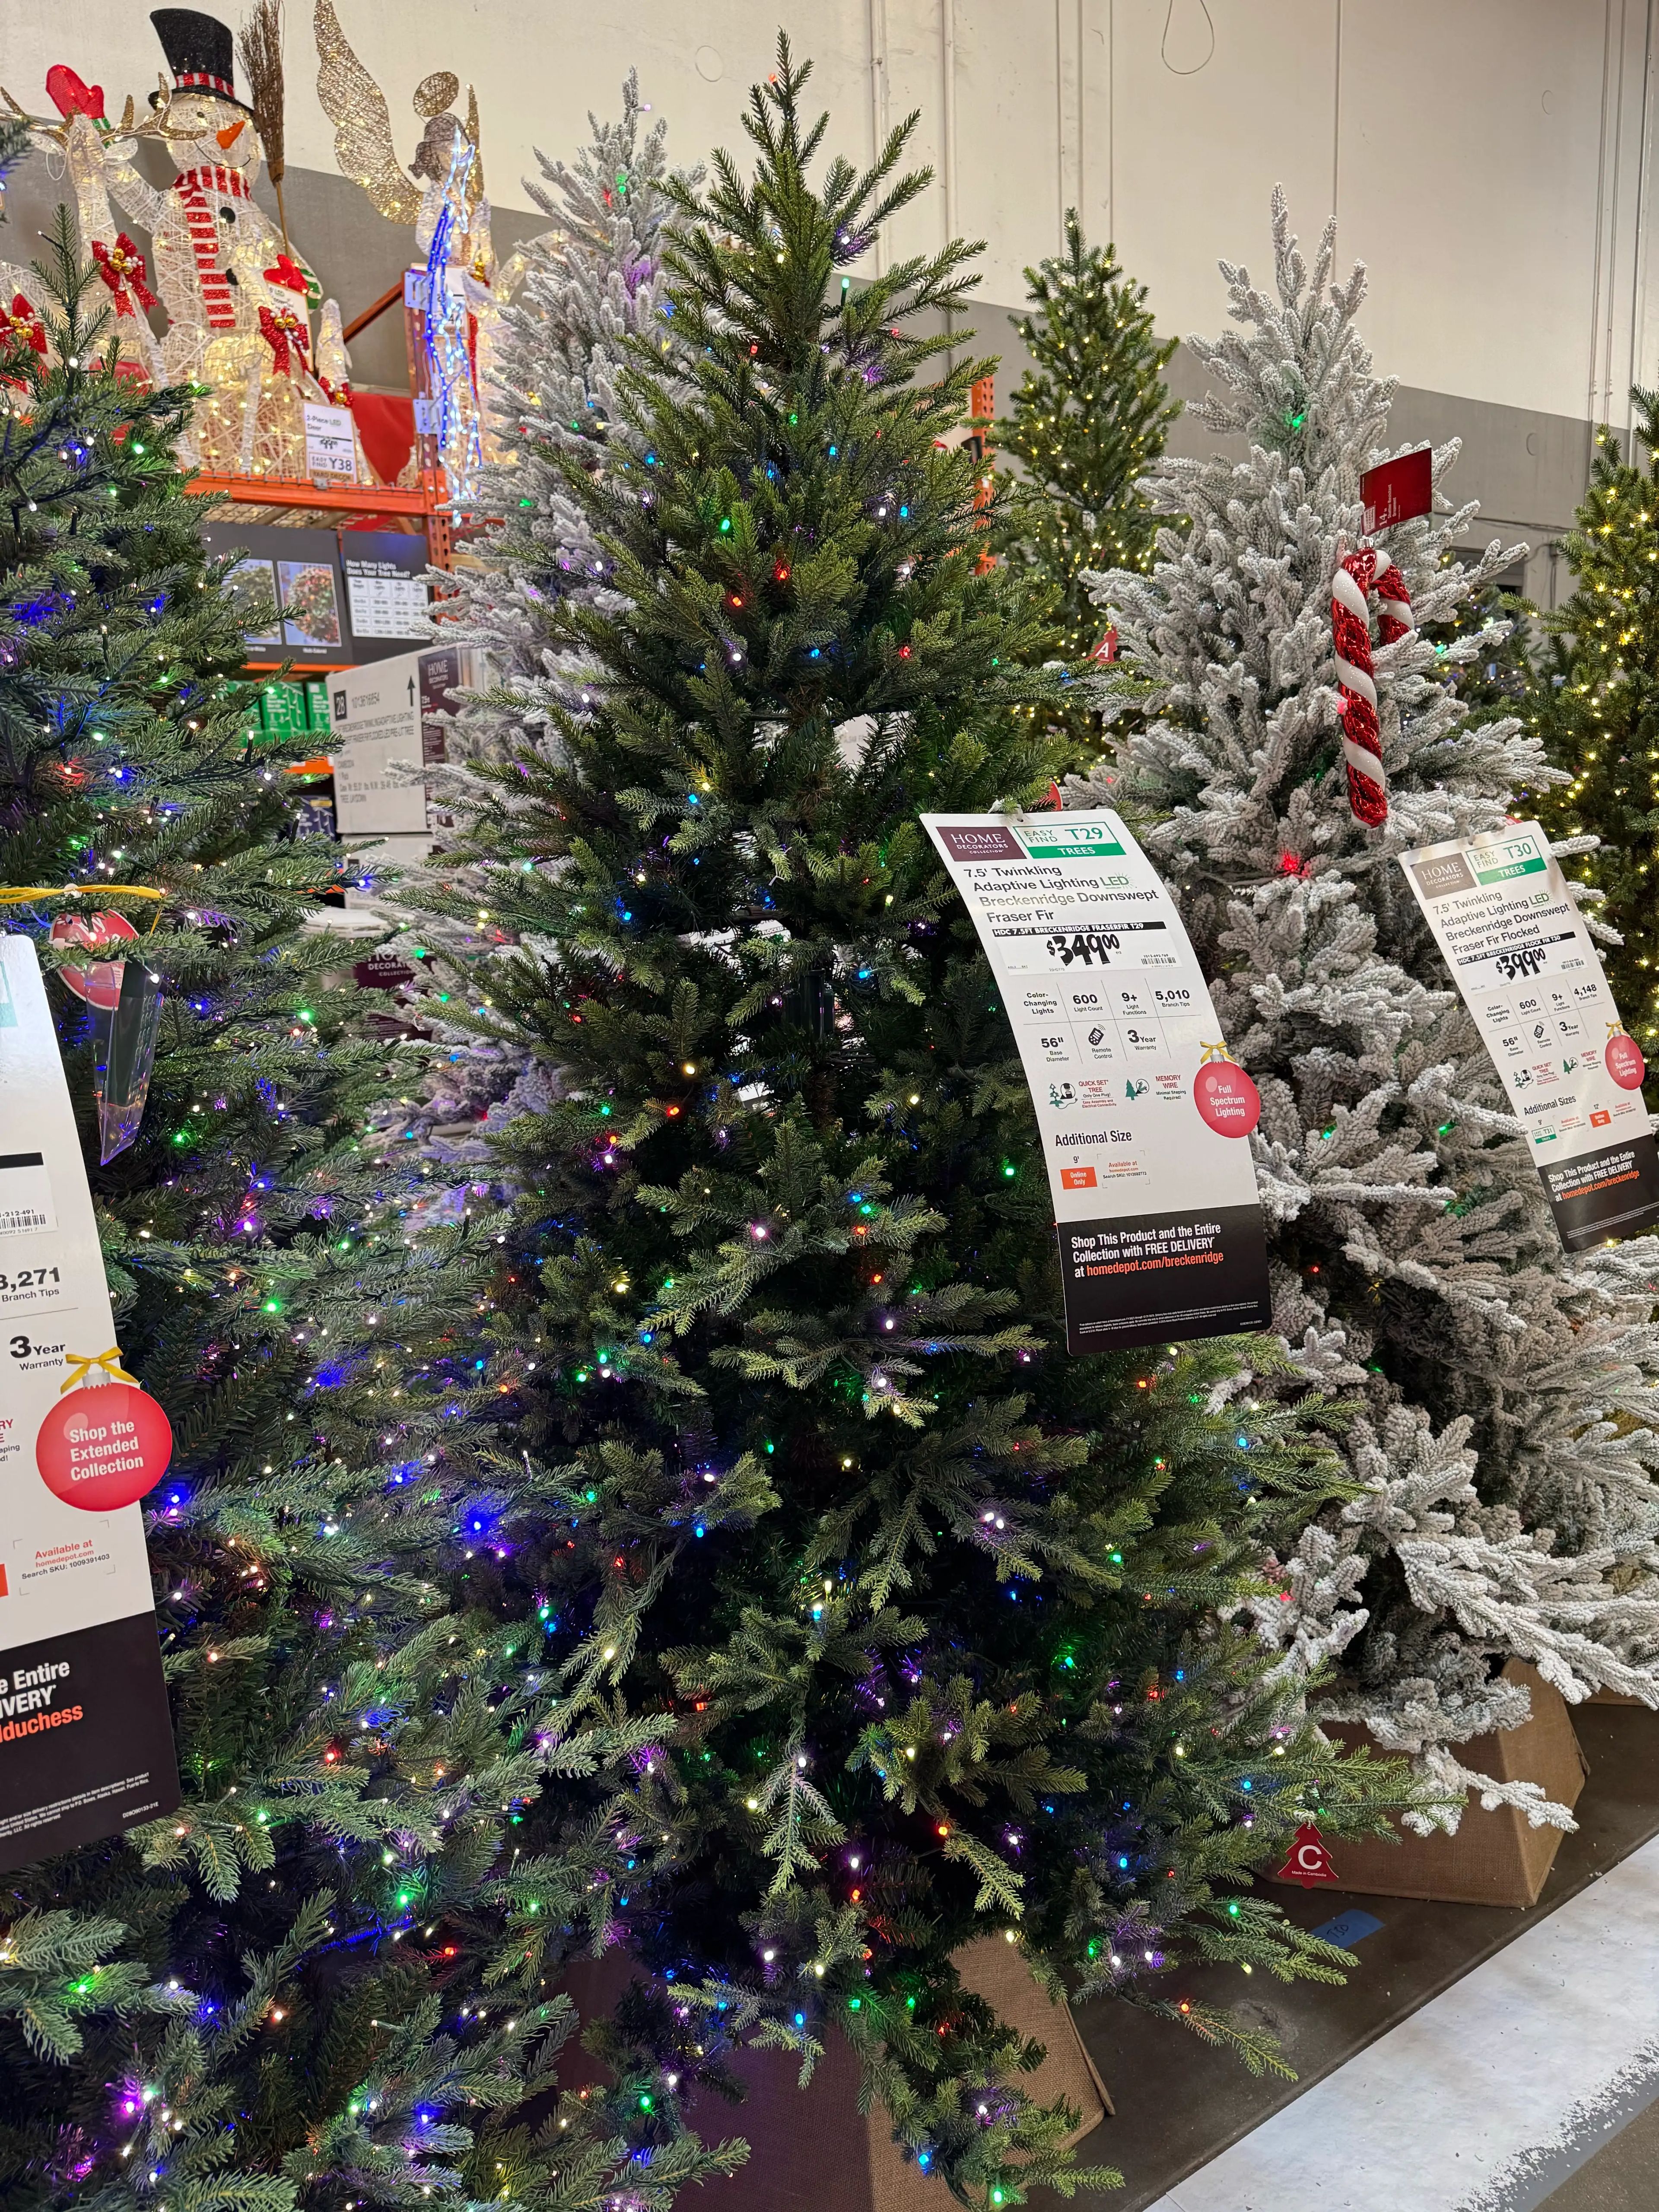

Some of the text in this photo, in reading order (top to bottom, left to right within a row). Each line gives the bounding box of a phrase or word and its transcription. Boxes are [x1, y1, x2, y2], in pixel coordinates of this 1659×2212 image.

[329, 457, 352, 471] Y38
[361, 561, 377, 569] Many
[378, 562, 396, 570] Lights
[1096, 642, 1109, 658] A
[427, 660, 448, 676] HOME
[951, 834, 1005, 844] HOME
[1065, 827, 1103, 840] T29
[1057, 847, 1096, 855] TREES
[1473, 851, 1495, 861] EASY
[1503, 843, 1532, 859] T30
[1421, 862, 1461, 880] HOME
[1477, 858, 1498, 868] FIND
[964, 866, 1062, 877] 7.5' Twinkling
[1426, 872, 1464, 885] DECORATORS
[1498, 865, 1526, 878] TREES
[974, 876, 1129, 892] Adaptive Lighting LED
[979, 890, 1159, 907] Breckenridge Downswept
[1433, 891, 1503, 915] 7.5' Twinkling
[986, 910, 1054, 922] Fraser Fir
[1441, 893, 1549, 928] Adaptive Lighting LED
[1446, 903, 1570, 941] Breckenridge Downswept
[1452, 925, 1540, 954] Fraser Fir Flocked
[1471, 953, 1486, 962] 7.5FT
[1487, 944, 1525, 958] BRECKENRIDGE
[1526, 940, 1541, 949] FLOCK
[1121, 993, 1137, 1001] 9+
[1155, 990, 1190, 1002] 5,010
[1574, 984, 1597, 996] 4,148
[1073, 994, 1097, 1004] 600
[1519, 999, 1537, 1009] 600
[1486, 1009, 1510, 1018] Changing
[1559, 1022, 1567, 1031] 3
[1041, 1037, 1064, 1048] 56"
[1127, 1030, 1139, 1043] 3
[1503, 1036, 1518, 1047] 56"
[1218, 1085, 1232, 1093] Full
[1210, 1096, 1245, 1106] Spectrum
[1524, 1096, 1576, 1116] Additional Sizes
[1215, 1107, 1245, 1118] Lighting
[1056, 1130, 1132, 1146] Additional Size
[1548, 1151, 1635, 1183] Shop This Product and the Entire
[1551, 1179, 1580, 1192] Collection
[1580, 1173, 1594, 1184] with
[1593, 1170, 1608, 1180] FREE
[1555, 1170, 1640, 1202] at homedepot.com/breckenridge
[1071, 1223, 1221, 1249] Shop This Product and the Entire
[1073, 1249, 1120, 1263] Collection
[1122, 1246, 1143, 1257] with
[1145, 1243, 1167, 1255] FREE
[1074, 1252, 1224, 1278] at homedepot.com/breckenridge
[2, 1289, 60, 1302] Branch Tips
[10, 1335, 66, 1358] 3 Year
[19, 1359, 64, 1370] Warranty
[70, 1421, 134, 1443] Shop the
[70, 1436, 139, 1462] Extended
[71, 1456, 144, 1481] Collection
[35, 1539, 93, 1560] Available at
[22, 1553, 110, 1579] Search SKU: 1009391403
[36, 1549, 94, 1568] homedepot.com
[13, 1662, 70, 1691] Entire
[0, 1705, 83, 1742] duchess
[1298, 1845, 1322, 1869] C
